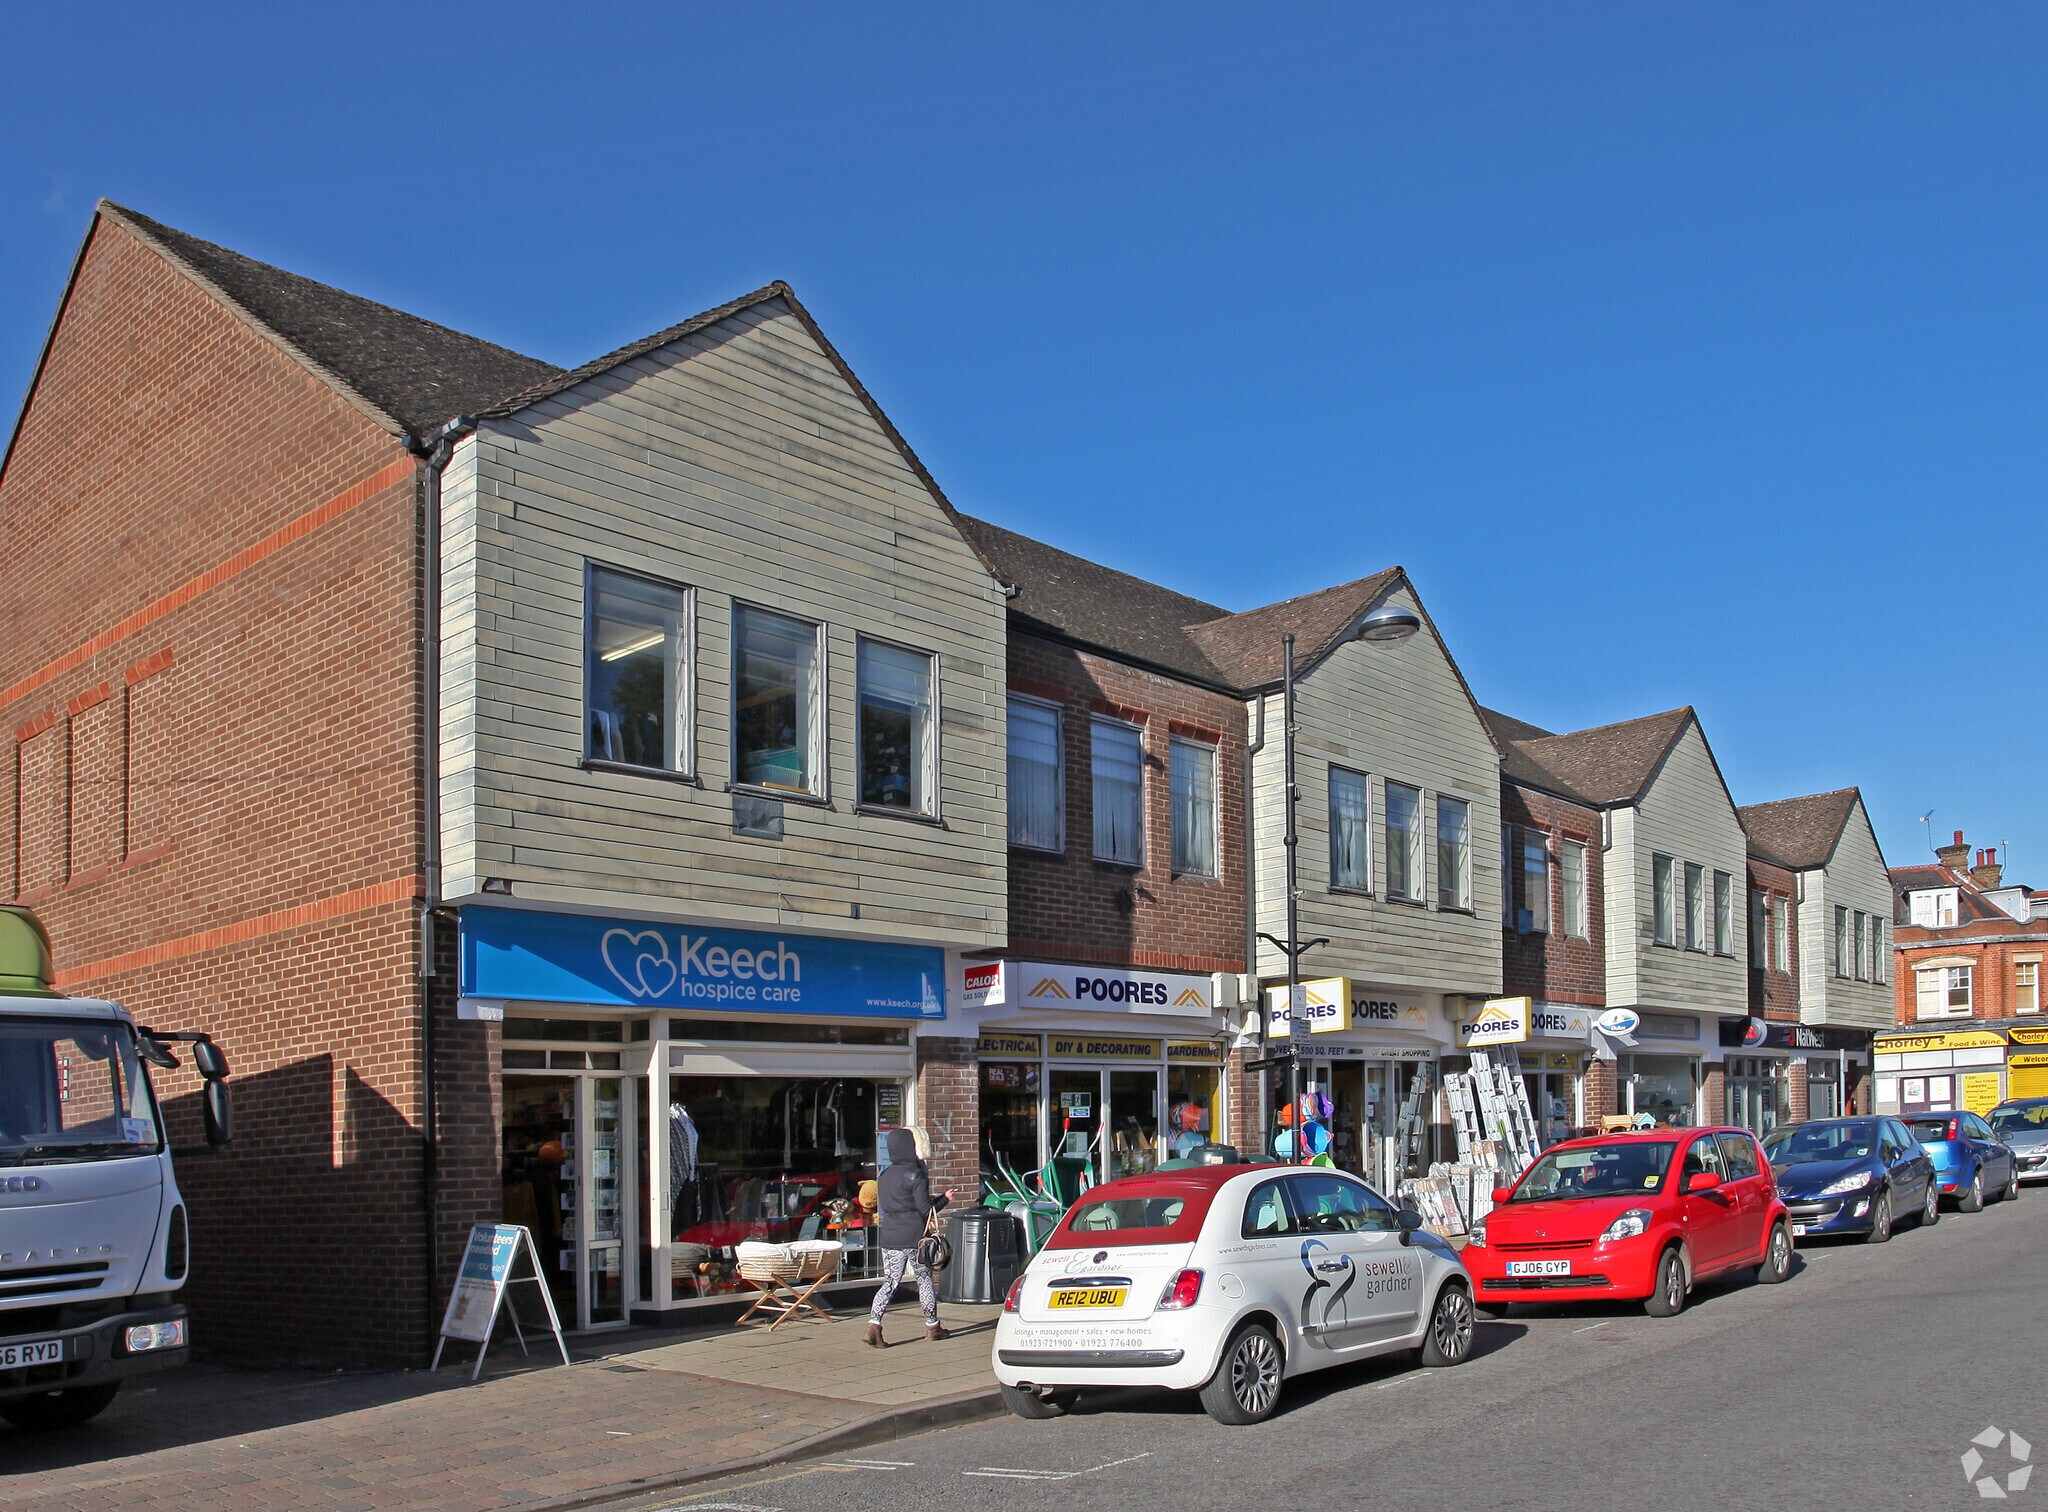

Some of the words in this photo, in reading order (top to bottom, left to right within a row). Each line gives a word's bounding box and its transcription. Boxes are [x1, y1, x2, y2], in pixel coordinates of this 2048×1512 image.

[680, 934, 801, 982] Keech
[966, 973, 1000, 988] CALOR
[681, 977, 756, 1002] hospice
[762, 985, 801, 1003] care
[963, 993, 973, 1001] GAS
[974, 991, 988, 999] SOLD
[1076, 977, 1168, 1005] POORES
[866, 997, 937, 1010] www.keech.org.uk
[1351, 1000, 1398, 1020] OORES
[1271, 1004, 1336, 1022] PORES
[1462, 1020, 1519, 1035] POORES
[1531, 1013, 1566, 1030] OORES
[977, 1038, 1037, 1052] LECTRICAL
[1056, 1041, 1073, 1053] DIY
[1077, 1043, 1083, 1053] &
[1087, 1043, 1151, 1055] DECORATING
[1167, 1045, 1220, 1057] GARDENING
[1315, 1047, 1326, 1056] SQ.
[1328, 1047, 1345, 1055] FEET
[1401, 1049, 1431, 1057] SHOPPING
[473, 1231, 514, 1245] Volunteers
[470, 1244, 501, 1256] needed
[1042, 1255, 1071, 1265] sewell
[1079, 1264, 1123, 1274] gardner
[1365, 1258, 1403, 1277] sewell
[1513, 1262, 1543, 1274] GJ06
[1545, 1261, 1568, 1273] GYP
[1366, 1276, 1413, 1299] gardner
[1057, 1291, 1088, 1306] RE12
[1089, 1290, 1118, 1305] UBU
[1014, 1327, 1034, 1337] lettings
[1039, 1328, 1080, 1338] management
[1086, 1327, 1103, 1336] sales
[1127, 1327, 1152, 1335] homes
[1020, 1339, 1042, 1348] 01923
[1044, 1339, 1073, 1348] 721900
[1080, 1338, 1107, 1347] 01923
[1110, 1338, 1143, 1347] 776400
[22, 1342, 59, 1363] RYD
